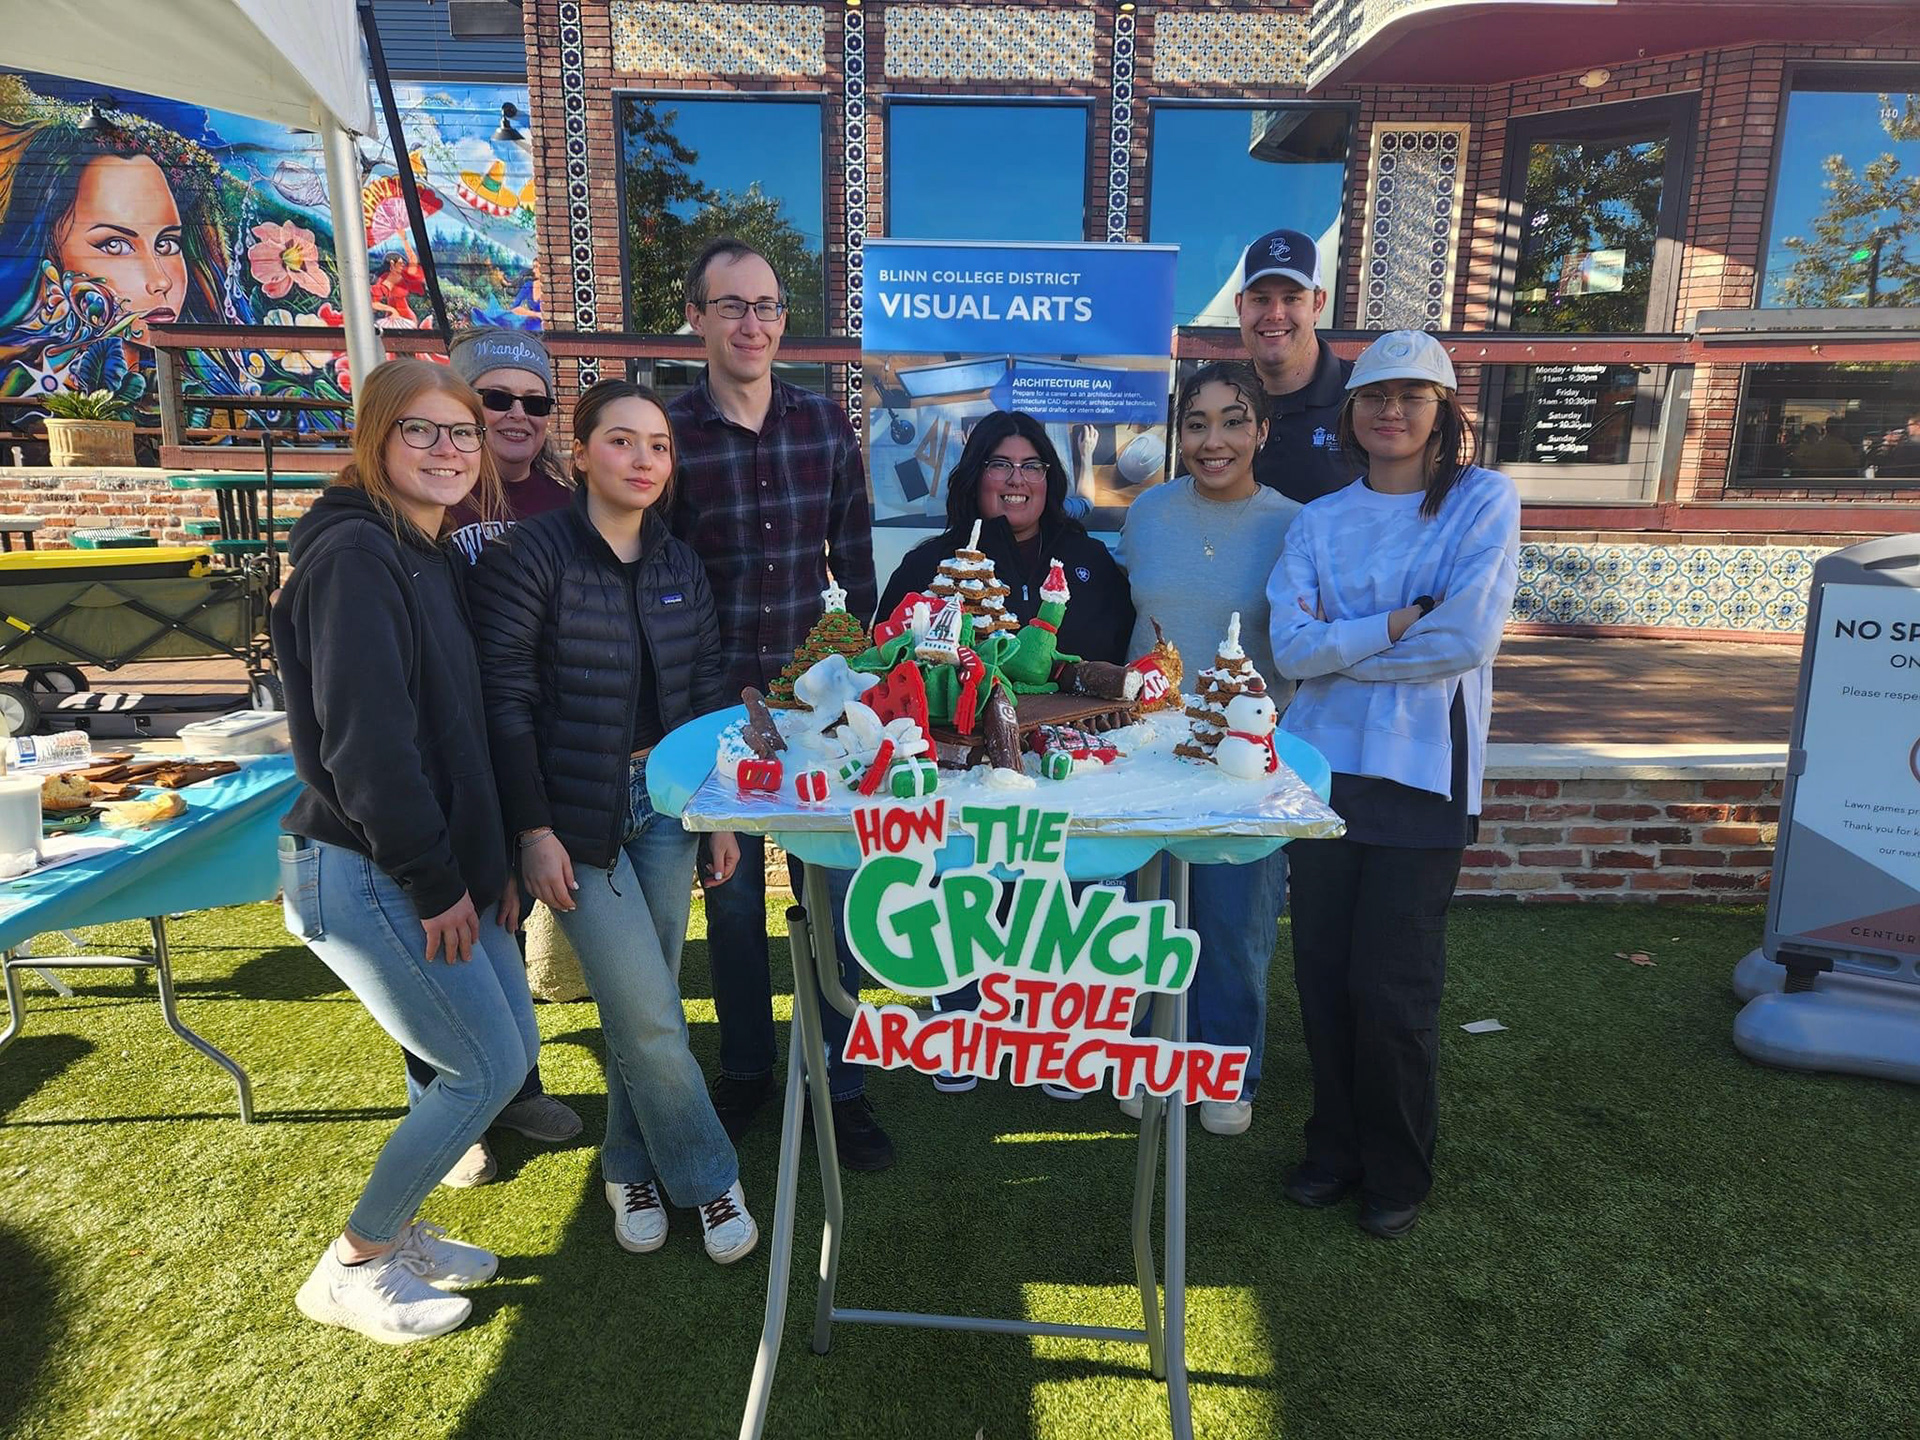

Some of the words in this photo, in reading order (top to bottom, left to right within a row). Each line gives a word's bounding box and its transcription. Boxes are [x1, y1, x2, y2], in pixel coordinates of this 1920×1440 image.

[879, 269, 927, 282] BLINN
[932, 270, 1004, 284] COLLEGE
[1008, 272, 1081, 285] DISTRICT
[878, 292, 1000, 320] VISUAL
[1006, 295, 1092, 322] ARTS
[475, 339, 540, 361] Wrangler
[1536, 366, 1566, 374] Monday
[1012, 378, 1090, 388] ARCHITECTURE
[1092, 379, 1112, 390] (AA)
[1569, 374, 1598, 383] 9:30pm
[1556, 388, 1580, 397] Friday
[1564, 397, 1597, 406] 10:30pm
[1548, 411, 1582, 420] Saturday
[1547, 434, 1577, 443] Sunday
[1834, 619, 1882, 640] NO
[1890, 654, 1920, 668] ON
[1842, 686, 1881, 698] Please
[1884, 691, 1920, 702] respe
[1844, 800, 1870, 809] Lawn
[1872, 804, 1905, 814] games
[854, 799, 945, 857] HOW
[962, 805, 1069, 865] THE
[1843, 820, 1873, 831] Thank
[1875, 825, 1893, 834] you
[1896, 825, 1911, 836] for
[1879, 847, 1896, 855] our
[1850, 926, 1916, 945] CENTUR
[980, 972, 1137, 1030] STOLE
[845, 1010, 1248, 1105] ARCHITECTURE
